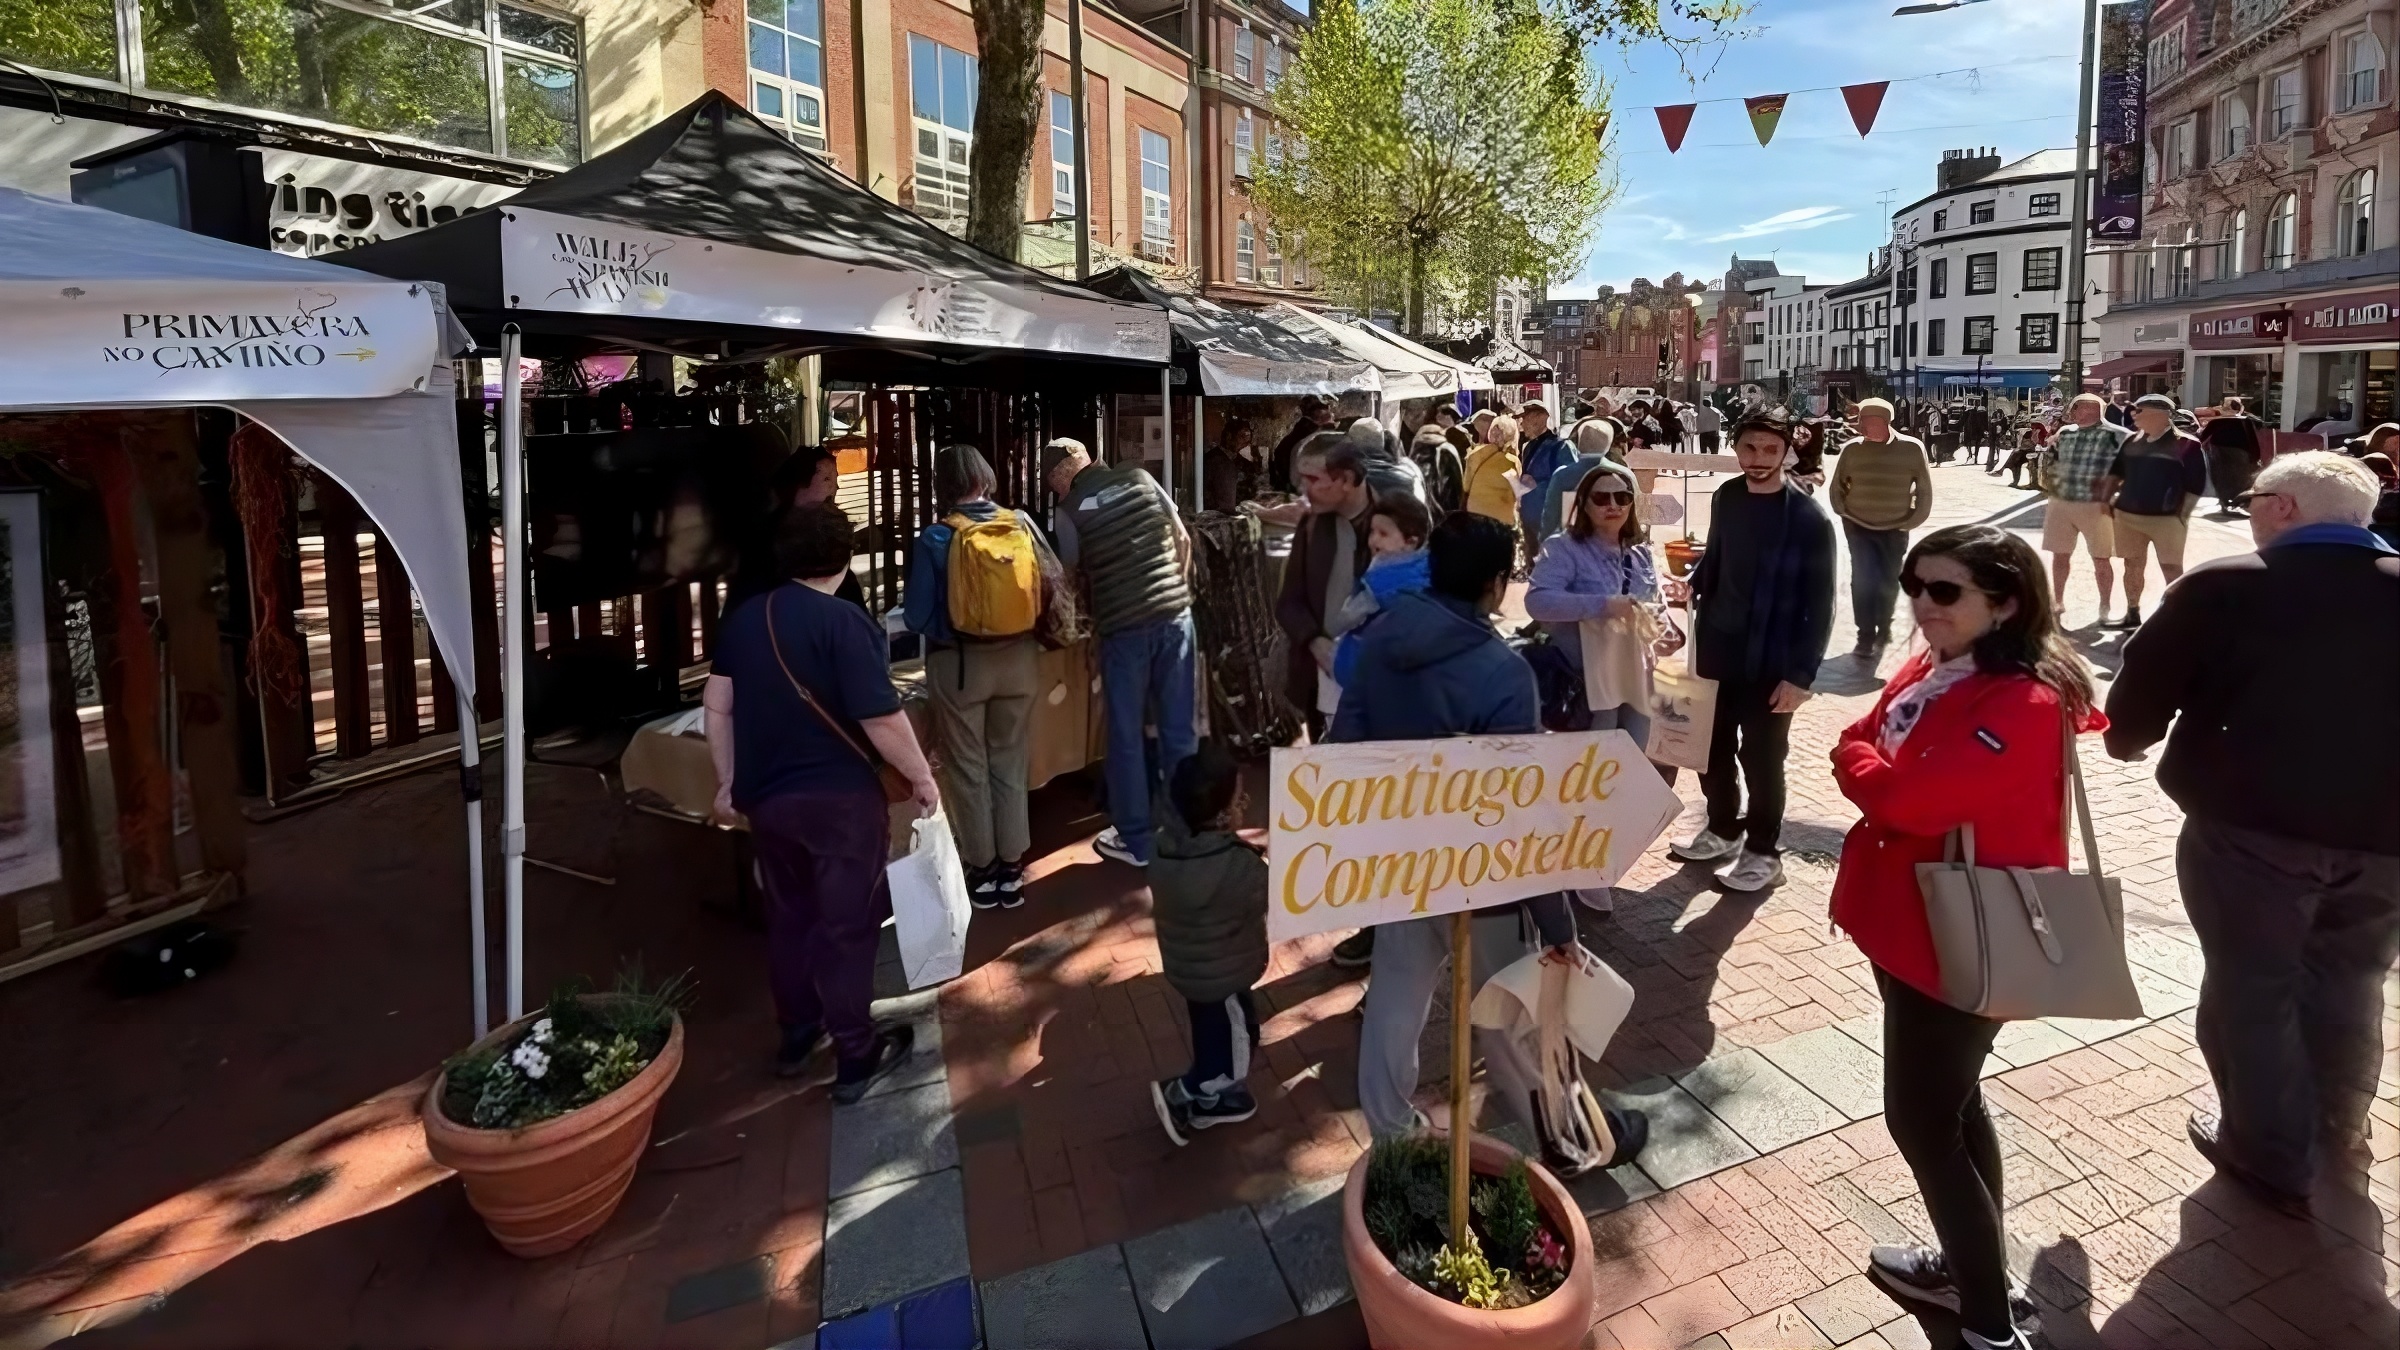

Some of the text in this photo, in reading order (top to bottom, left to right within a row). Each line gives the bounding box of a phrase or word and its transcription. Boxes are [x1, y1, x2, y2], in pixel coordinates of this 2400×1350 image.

[264, 172, 374, 230] ing
[102, 346, 145, 362] NO
[122, 313, 371, 338] PRIMAVERA
[1278, 743, 1621, 832] Santiago de
[1282, 814, 1614, 915] Compostela
